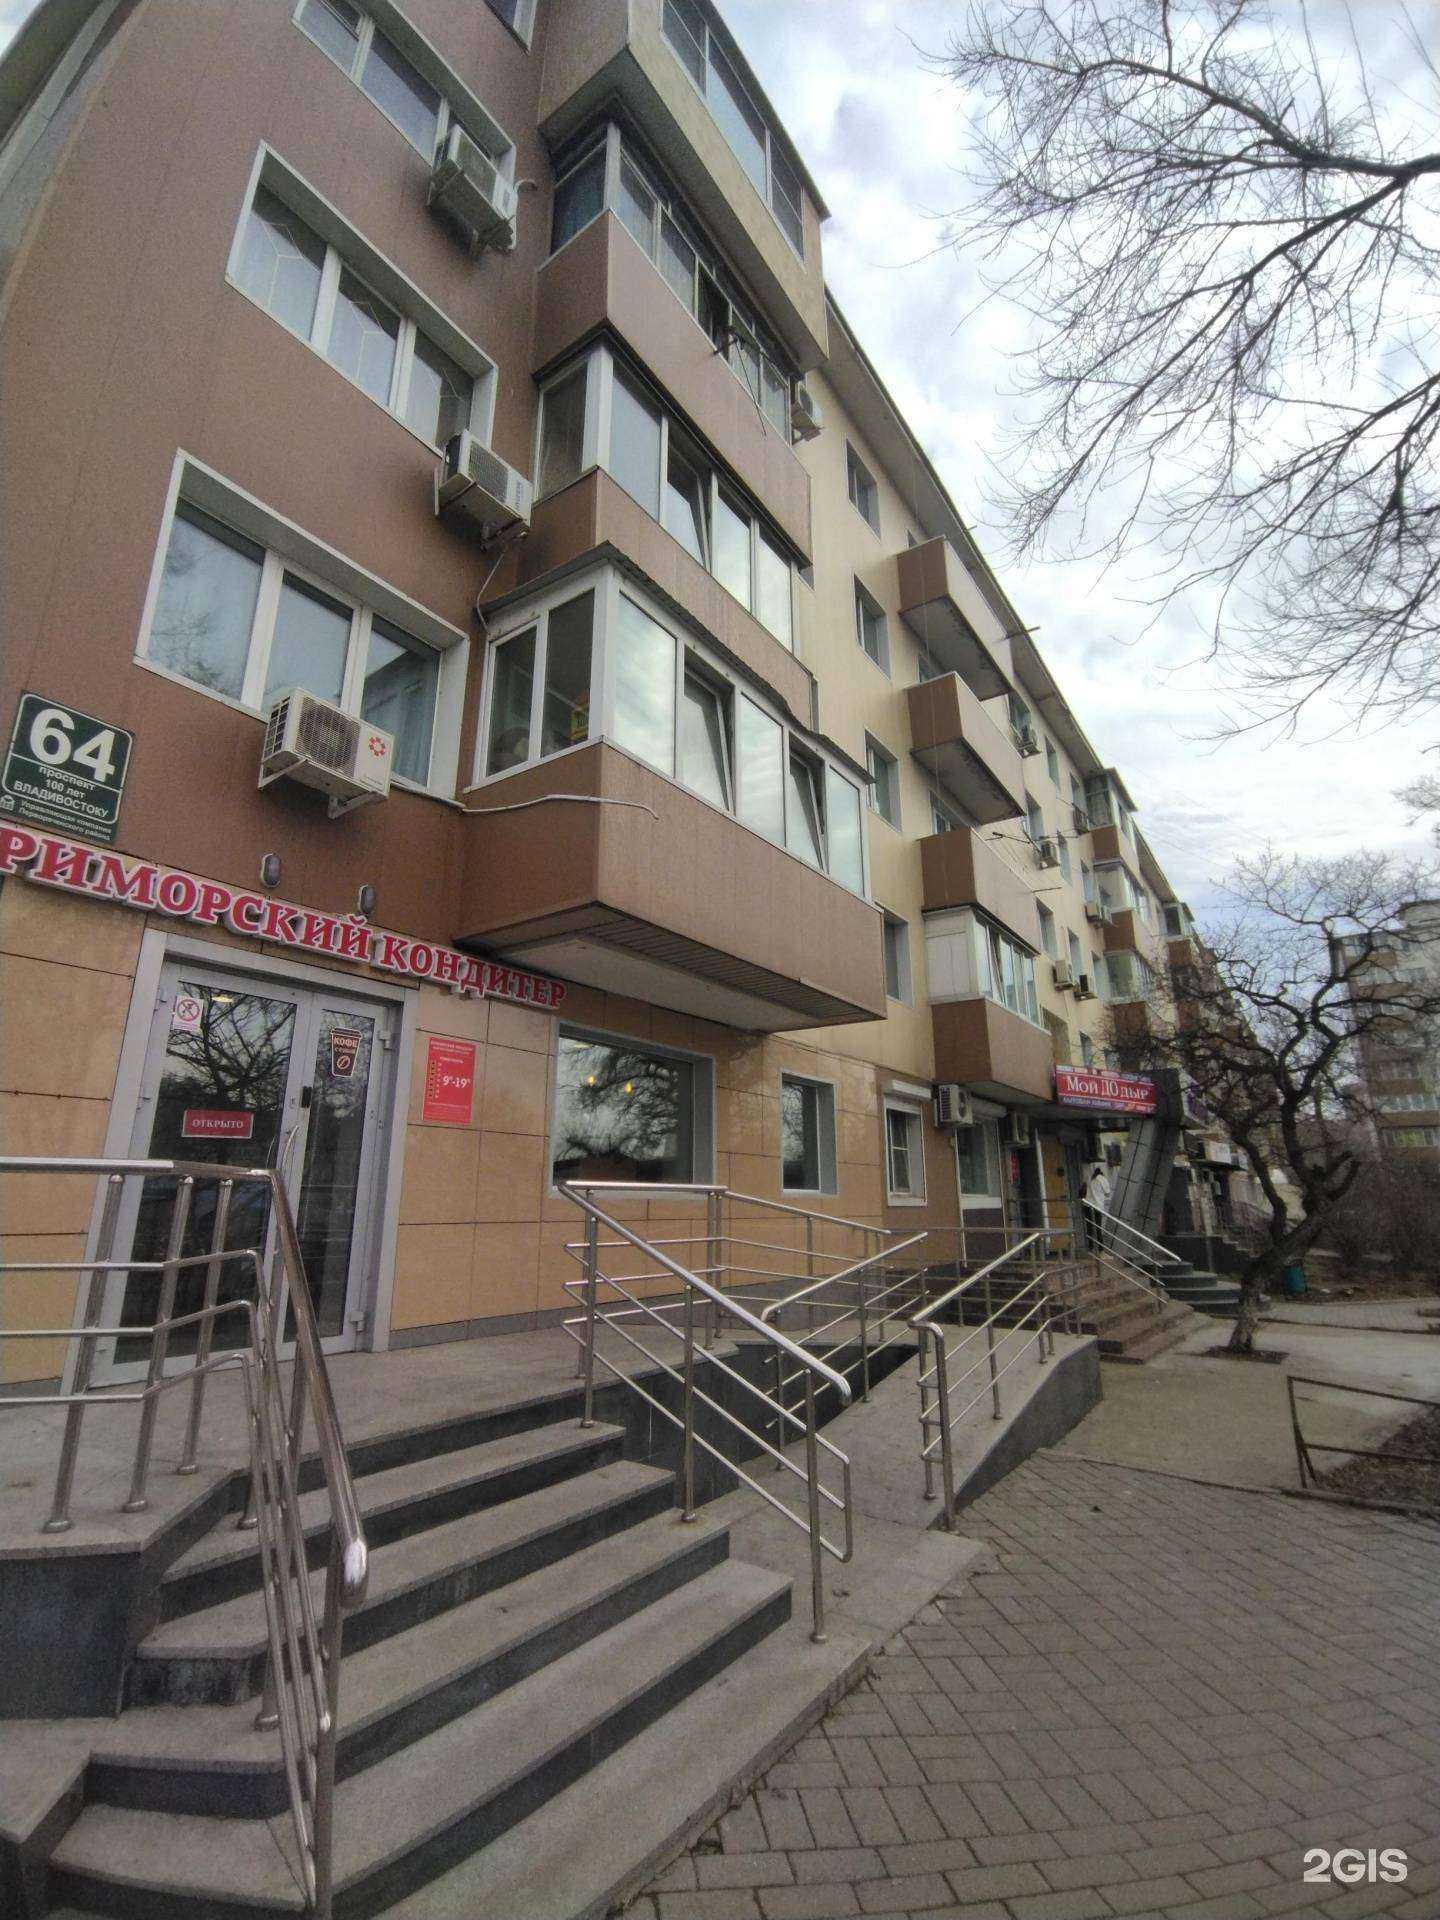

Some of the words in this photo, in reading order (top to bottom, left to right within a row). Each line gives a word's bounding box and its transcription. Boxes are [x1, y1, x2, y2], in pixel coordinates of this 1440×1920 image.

[30, 708, 116, 782] 64
[39, 766, 96, 791] проспект
[46, 779, 64, 793] 100
[67, 787, 86, 799] лет
[14, 780, 108, 818] ВЛАДИВОСТОКУ
[380, 934, 566, 1009] КОНДИТЕР
[334, 1037, 358, 1048] КОФЕ
[1066, 1075, 1098, 1094] Мой
[192, 1119, 244, 1129] ОТКРЫТО
